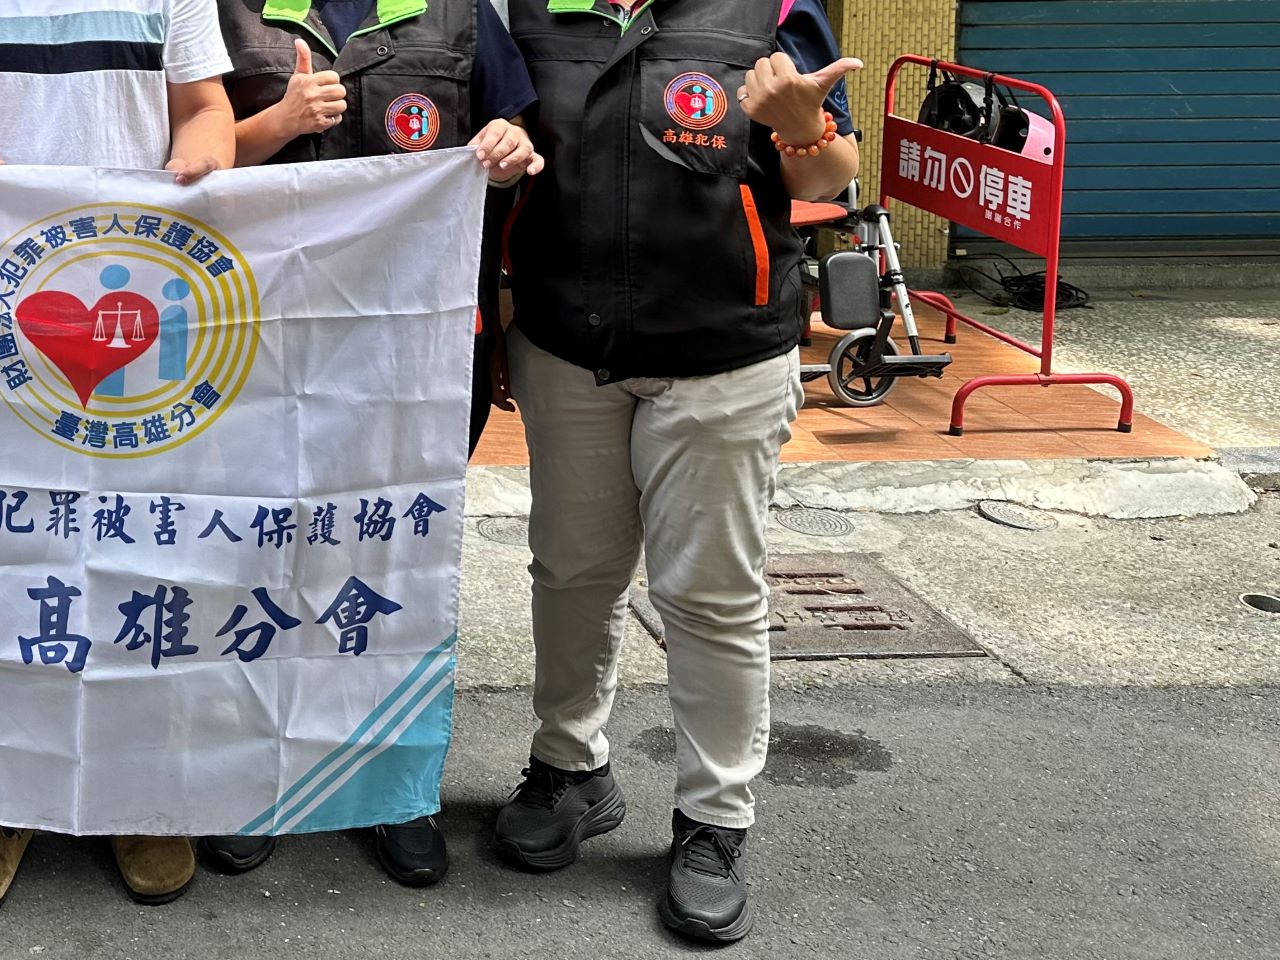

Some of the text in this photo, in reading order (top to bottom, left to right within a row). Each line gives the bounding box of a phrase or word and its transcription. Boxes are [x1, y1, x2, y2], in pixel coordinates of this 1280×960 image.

[662, 128, 728, 150] 高雄犯保
[898, 138, 1034, 222] 請勿停車
[983, 209, 1023, 231] 謝謝合作
[51, 379, 223, 450] 臺灣高雄分會
